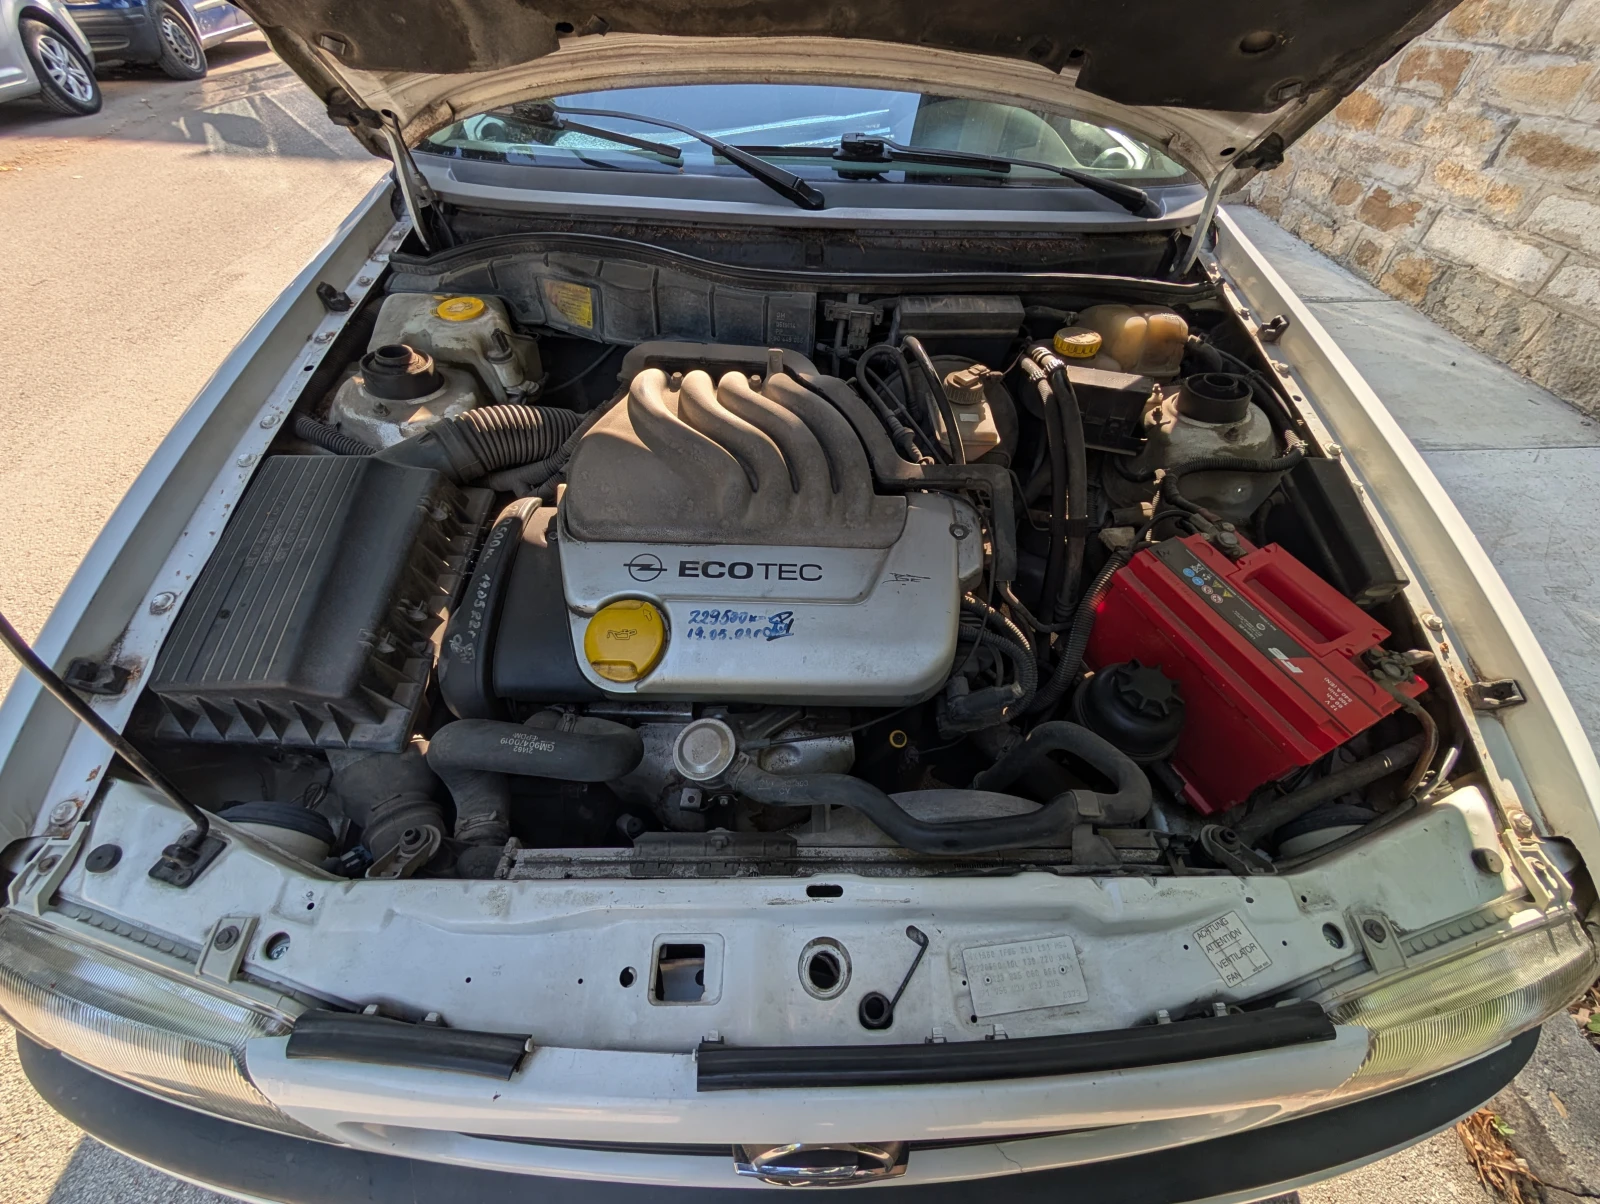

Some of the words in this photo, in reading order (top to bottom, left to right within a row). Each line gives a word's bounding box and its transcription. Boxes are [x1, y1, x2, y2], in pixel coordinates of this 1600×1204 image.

[678, 560, 823, 581] ECOTEC
[1196, 917, 1229, 941] ACHTUNG
[1205, 928, 1242, 953] ATTENTION
[1216, 942, 1258, 969] VENTILATOR
[1226, 971, 1241, 984] FAN
